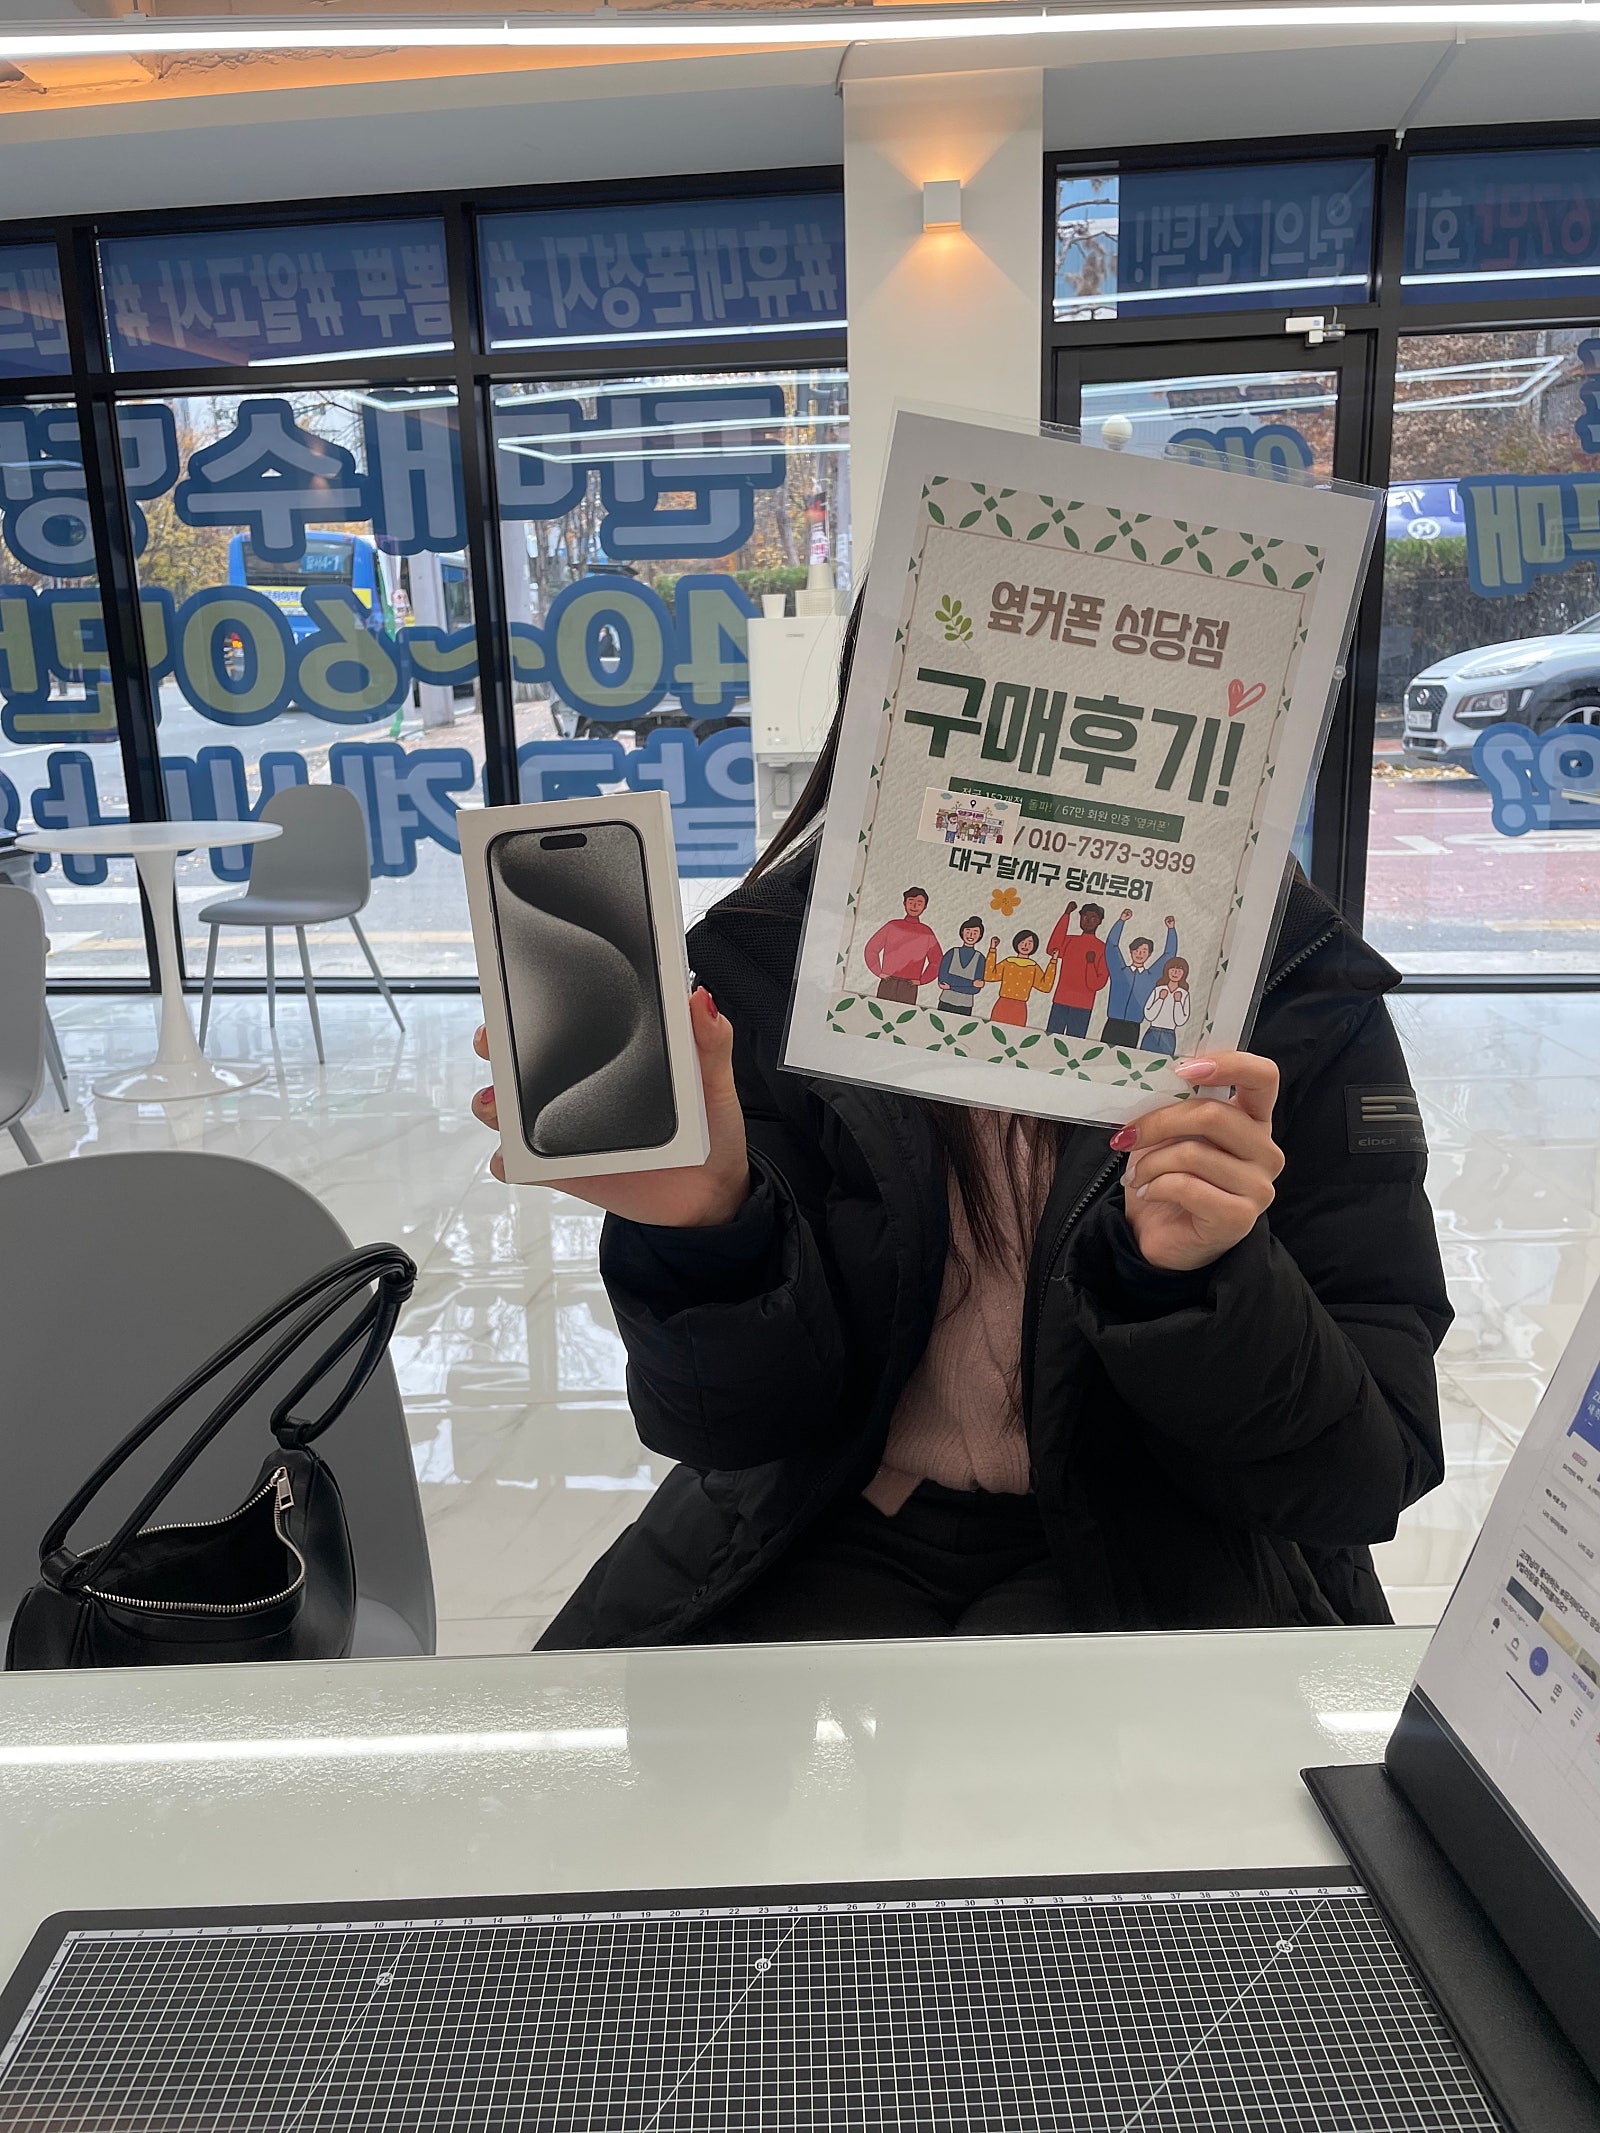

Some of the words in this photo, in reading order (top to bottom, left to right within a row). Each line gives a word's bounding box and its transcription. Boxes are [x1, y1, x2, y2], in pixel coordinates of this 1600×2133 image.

[987, 581, 1105, 647] 옆커폰
[1112, 604, 1230, 669] 성당점
[904, 667, 1246, 807] 구매후기!
[1062, 804, 1086, 819] 67만
[1087, 808, 1110, 823] 회원
[1111, 813, 1131, 826] 인증
[949, 847, 992, 875] 대구
[996, 855, 1061, 887] 달서구
[1064, 866, 1154, 902] 당산로81
[1028, 828, 1196, 875] 010-7373-3939
